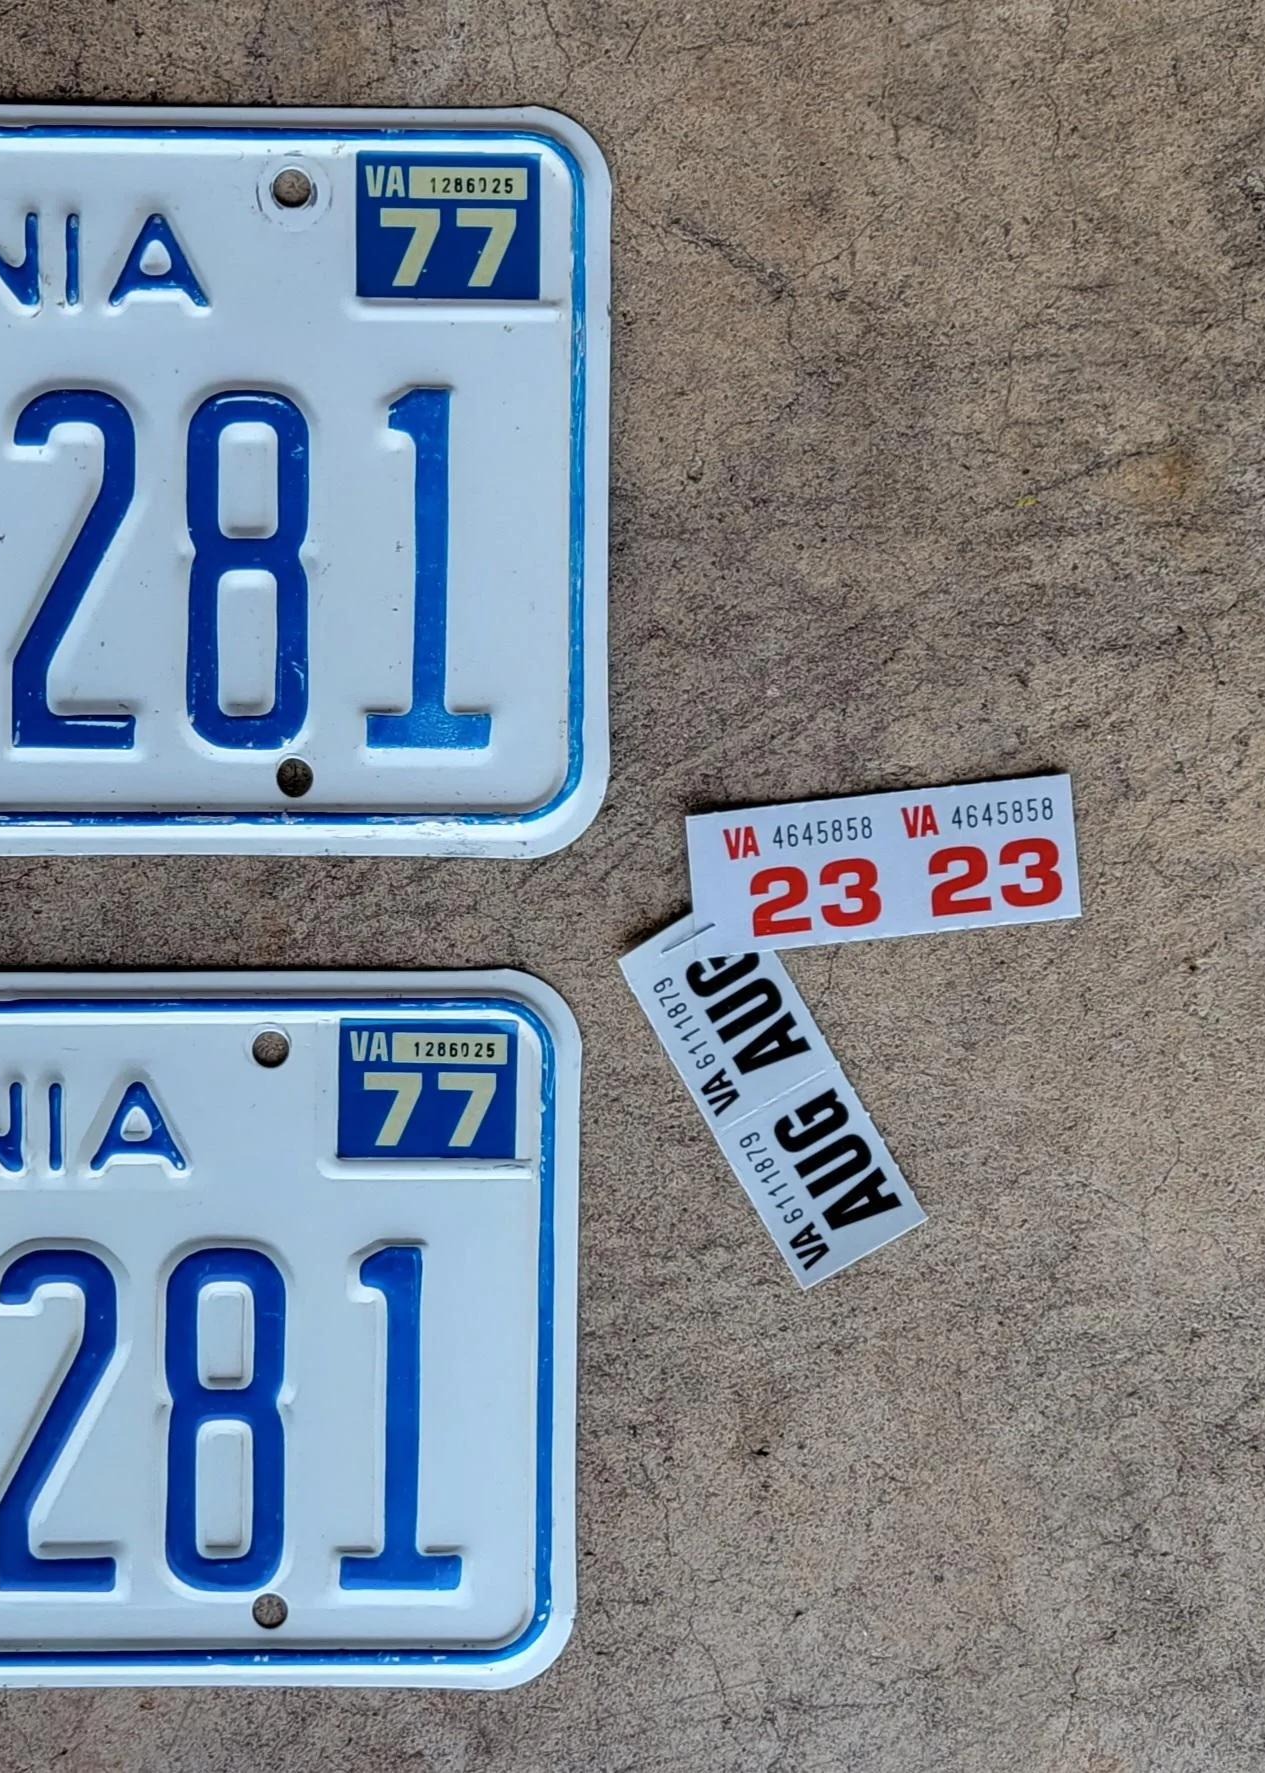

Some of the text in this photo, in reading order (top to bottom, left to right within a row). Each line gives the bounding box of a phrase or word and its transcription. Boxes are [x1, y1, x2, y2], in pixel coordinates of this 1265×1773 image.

[364, 165, 514, 198] VA 1286025
[379, 207, 517, 287] 77
[11, 385, 492, 751] 281
[722, 816, 874, 861] VA 4645858
[900, 797, 1055, 839] VA 4645858
[748, 856, 883, 937] 23
[927, 837, 1064, 918] 23
[349, 1030, 496, 1062] VA 1286025
[652, 976, 741, 1118] VA 6111879
[685, 952, 813, 1076] AUG
[363, 1071, 497, 1148] 77
[773, 1087, 903, 1231] AUG
[738, 1130, 831, 1271] VA 6111879
